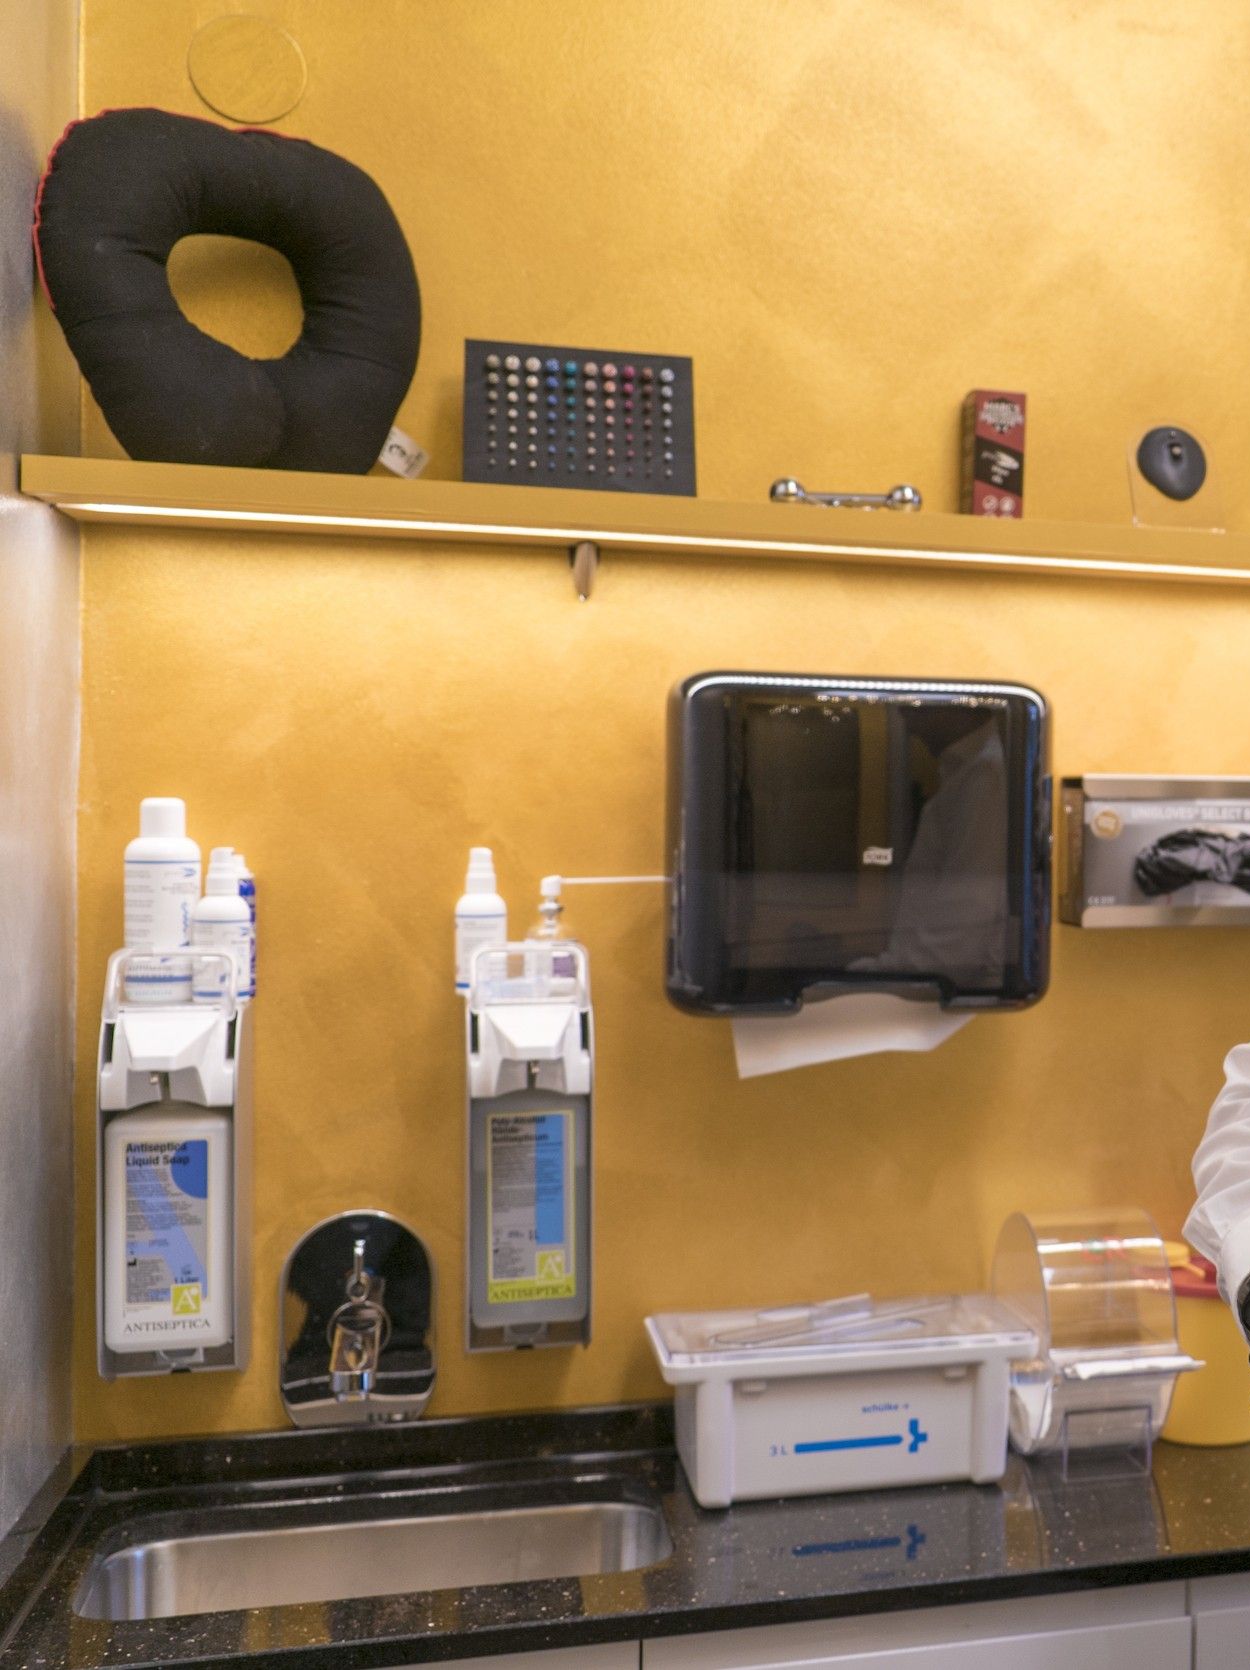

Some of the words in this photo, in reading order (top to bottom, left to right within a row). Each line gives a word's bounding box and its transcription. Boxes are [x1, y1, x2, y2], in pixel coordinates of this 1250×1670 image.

[125, 1142, 188, 1154] Antiseptica
[126, 1155, 160, 1167] Liquid
[162, 1154, 190, 1166] Soap
[492, 1285, 574, 1300] ANTISEPTICA
[124, 1319, 211, 1334] ANTISEPTICA
